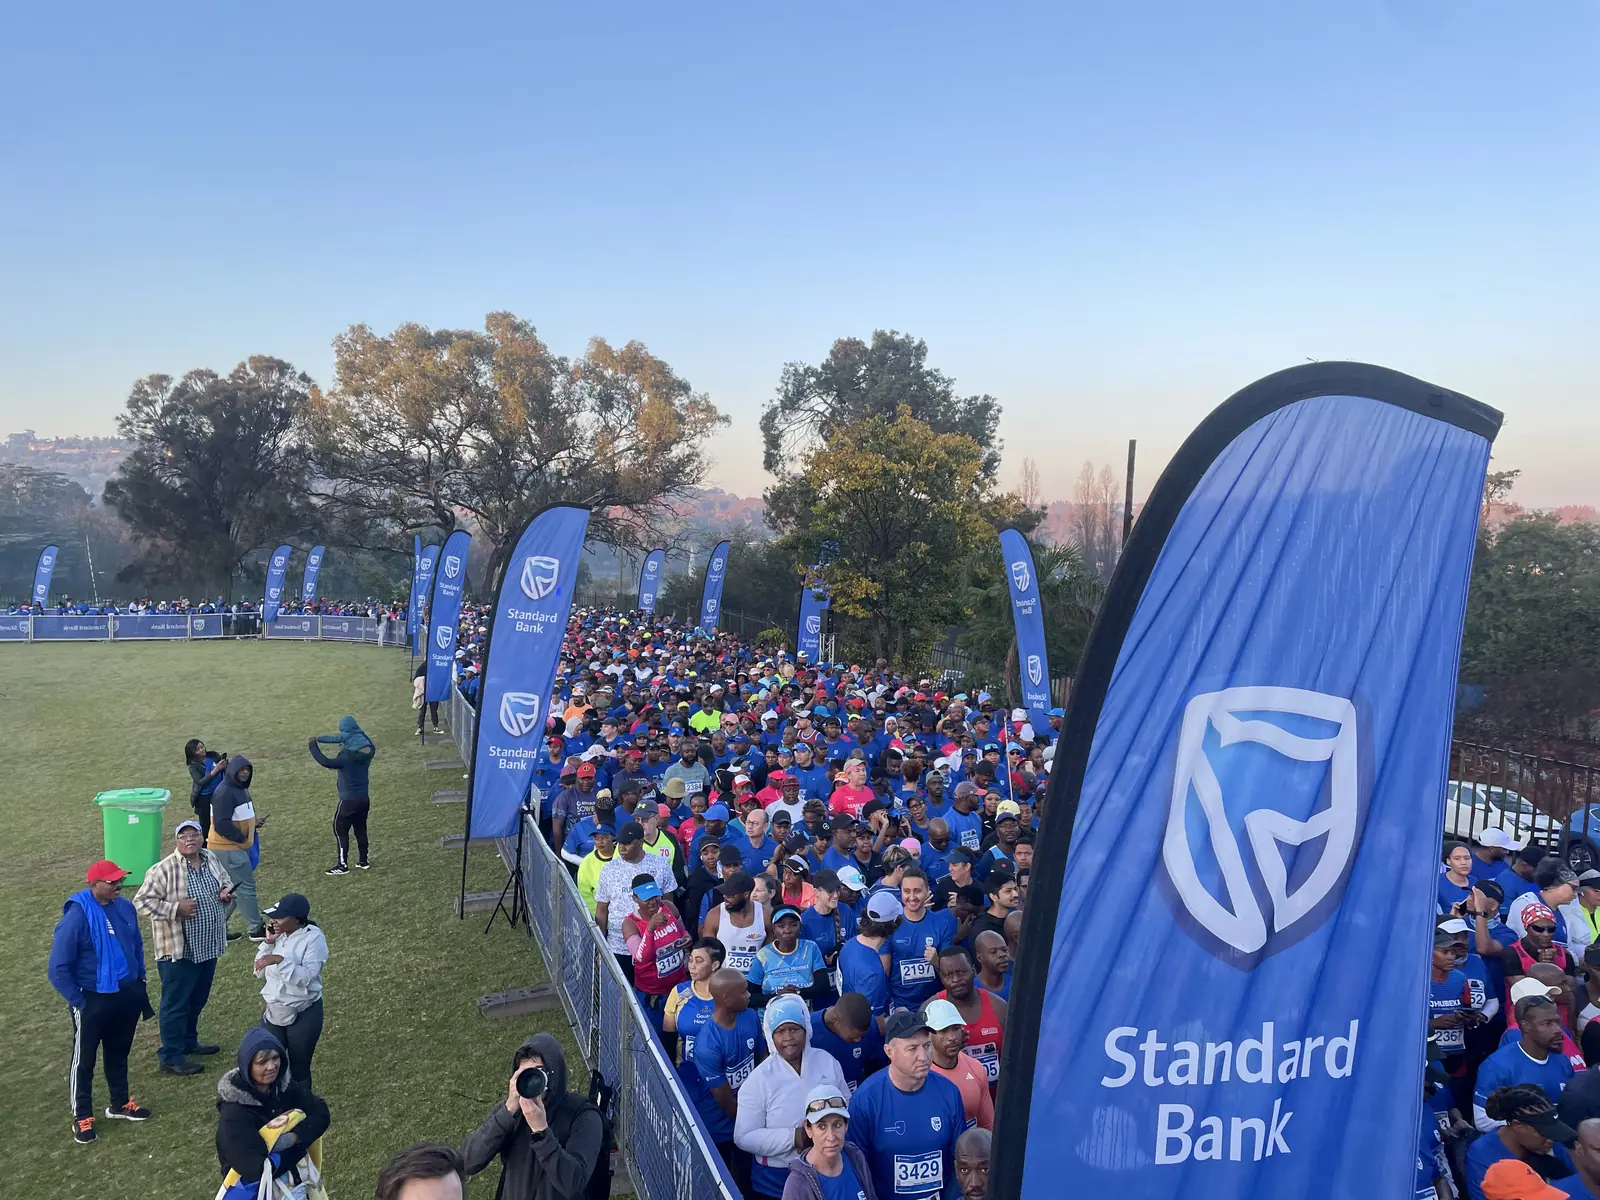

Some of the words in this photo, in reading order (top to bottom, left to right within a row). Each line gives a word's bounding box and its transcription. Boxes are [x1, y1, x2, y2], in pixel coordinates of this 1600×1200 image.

[440, 582, 460, 592] Standard
[442, 589, 455, 597] Bank
[507, 608, 558, 624] Standard
[515, 622, 544, 634] Bank
[432, 653, 454, 661] Standard
[489, 746, 537, 759] Standard
[498, 759, 527, 771] Bank
[660, 848, 670, 857] 70
[658, 952, 682, 971] 3141
[903, 963, 931, 977] 2197
[1101, 1018, 1360, 1088] Standard
[727, 1061, 754, 1086] 1351
[1155, 1097, 1294, 1165] Bank
[898, 1160, 940, 1181] 3429
